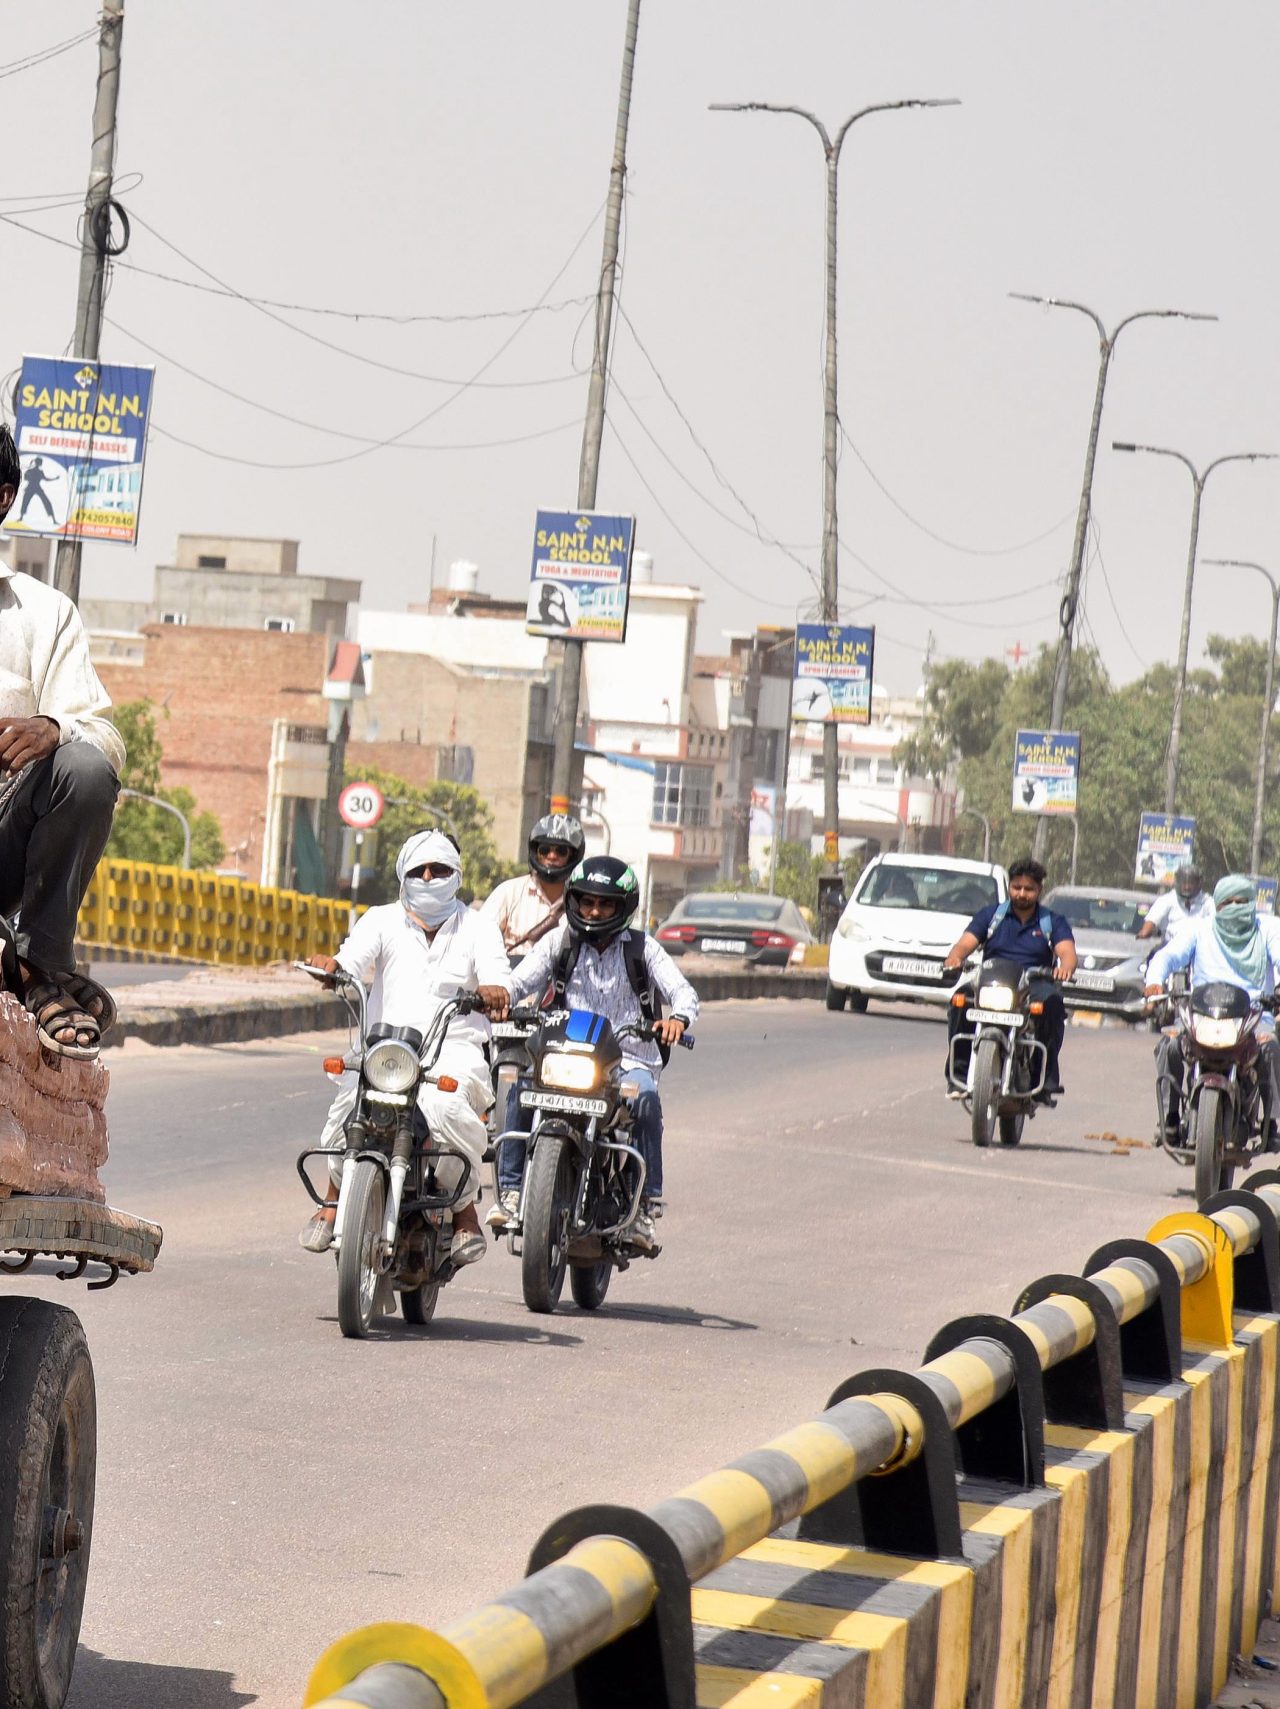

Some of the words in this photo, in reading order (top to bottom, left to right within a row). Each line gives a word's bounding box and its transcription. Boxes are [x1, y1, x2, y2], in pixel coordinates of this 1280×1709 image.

[22, 384, 89, 412] SAINT
[97, 392, 144, 418] N.N.
[38, 409, 122, 435] SCHOOL
[28, 435, 48, 446] SELF
[537, 530, 587, 549] SAINT
[593, 534, 626, 552] N.N.
[549, 548, 611, 565] SCHOOL
[540, 565, 561, 574] YOGA
[571, 567, 618, 578] MEDITATION
[798, 638, 838, 655] SAINT
[808, 651, 858, 665] SCHOOL
[349, 796, 373, 813] 30
